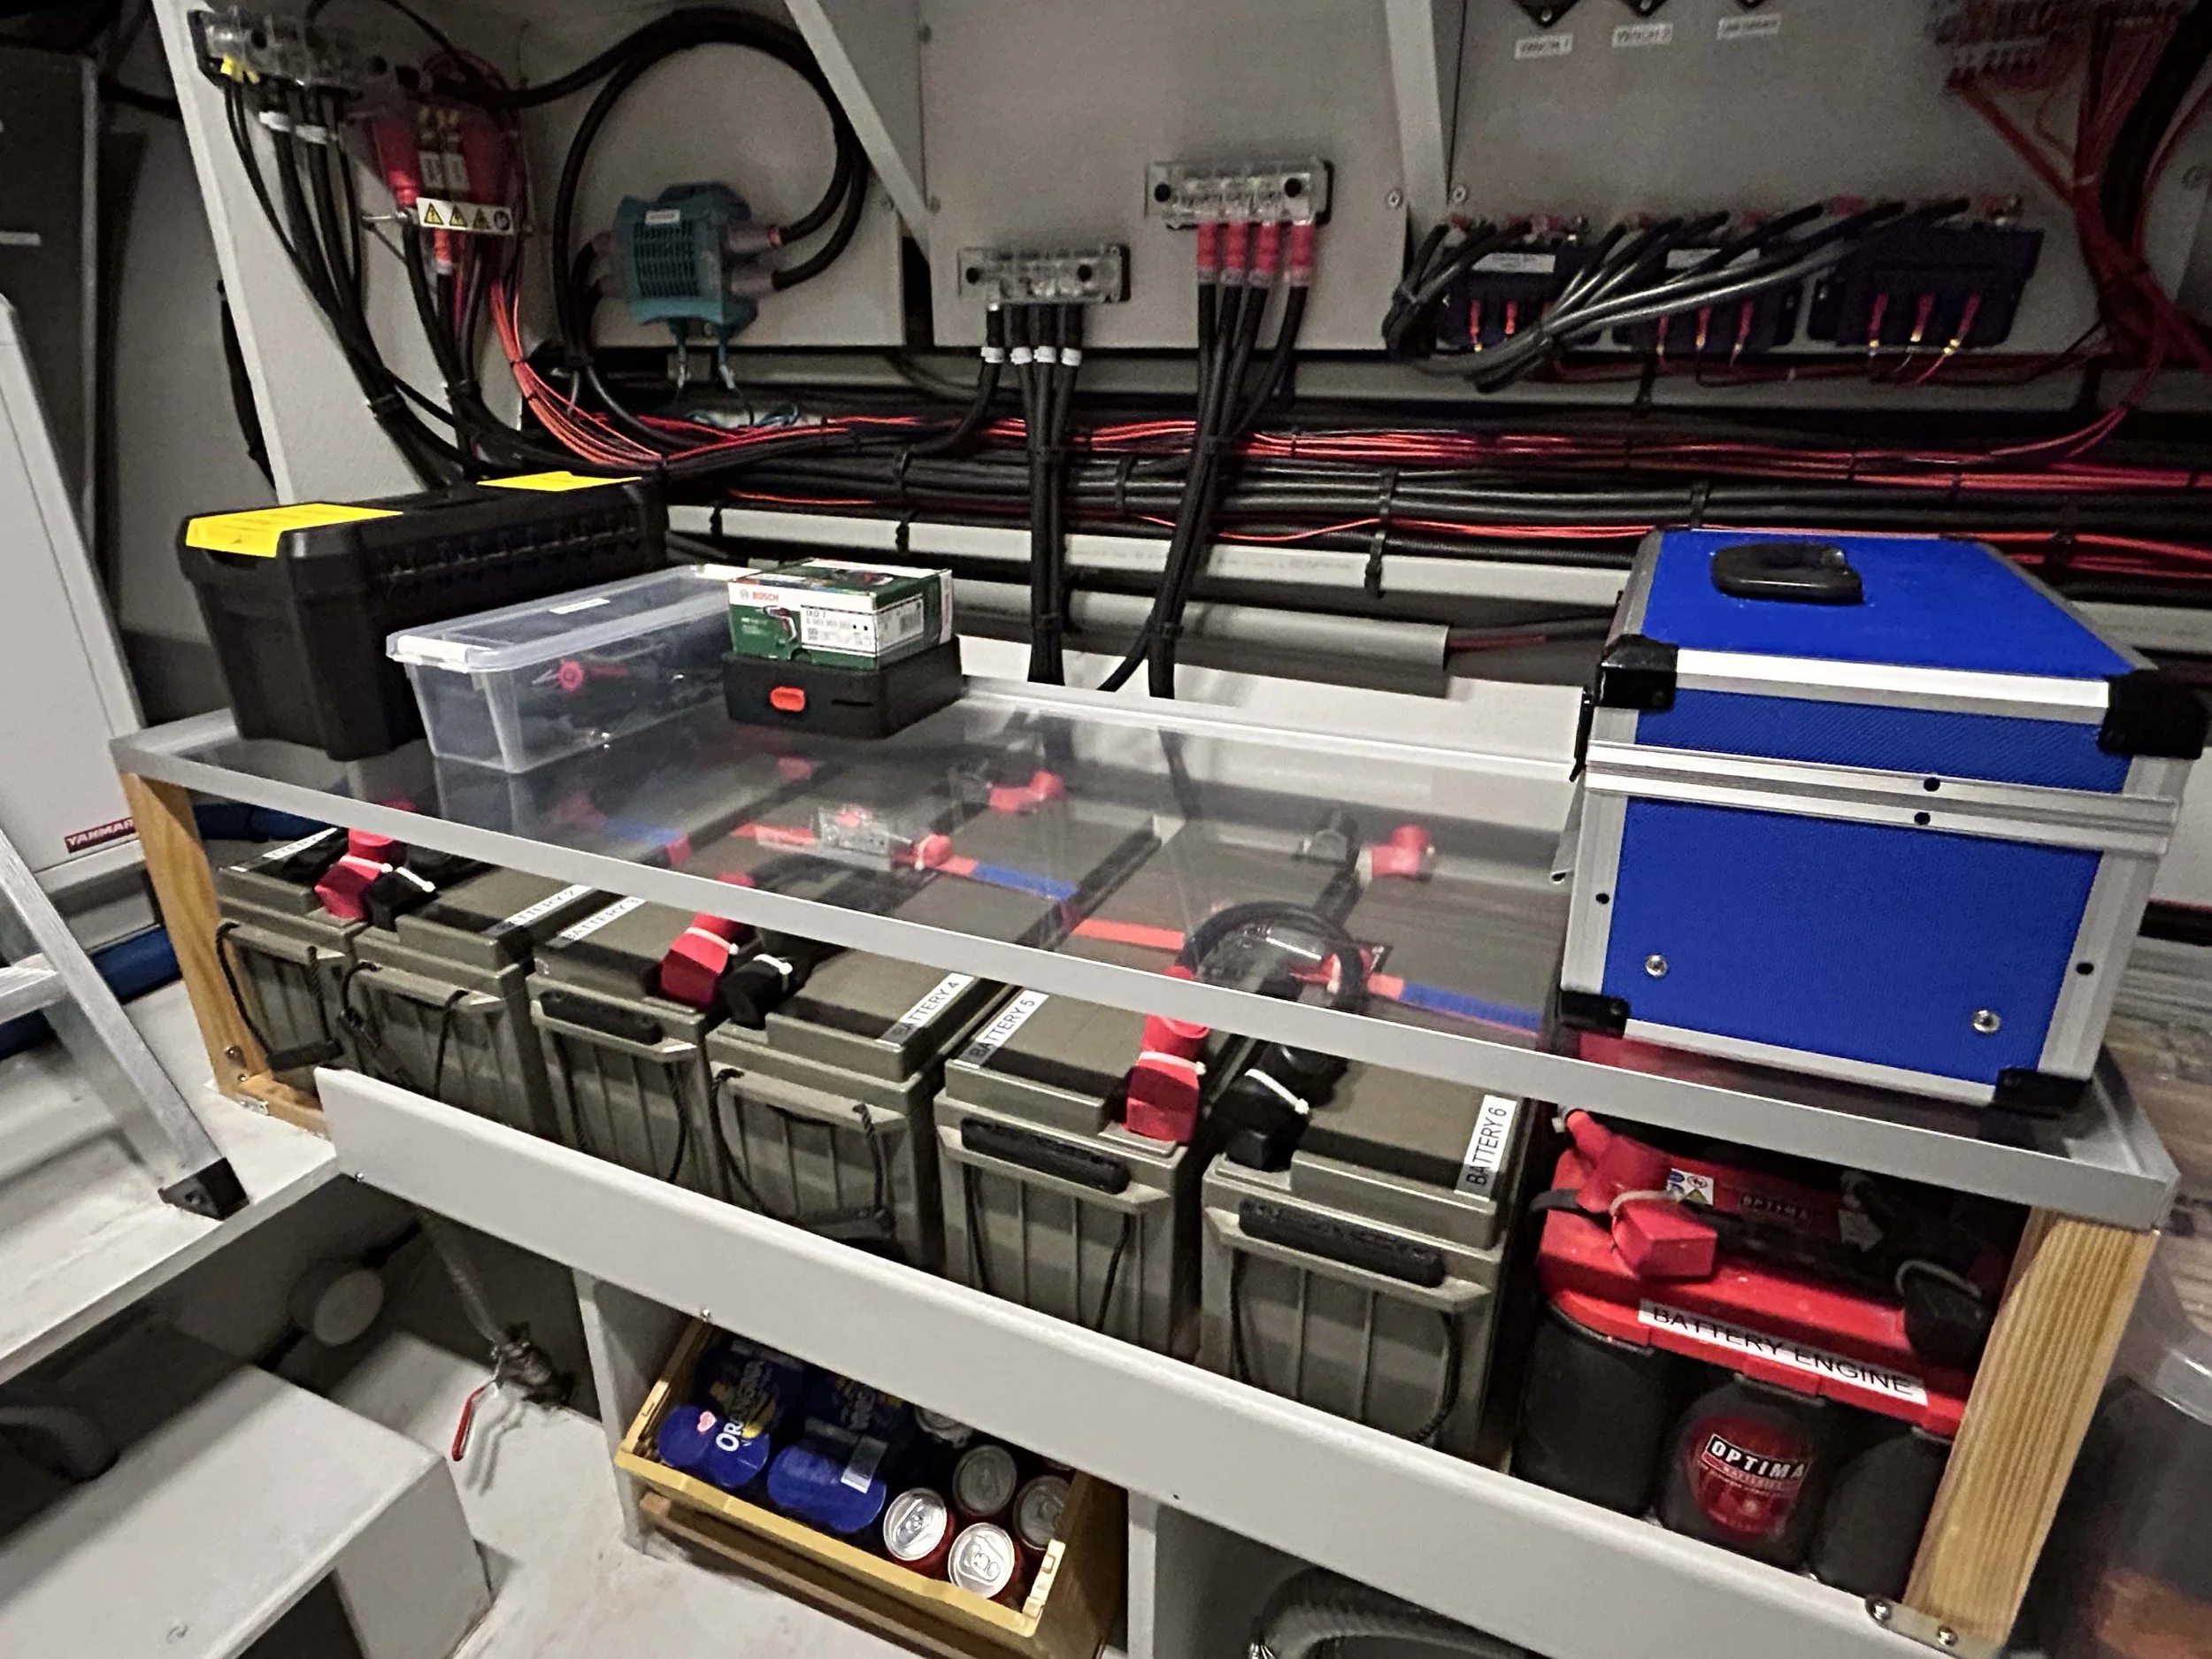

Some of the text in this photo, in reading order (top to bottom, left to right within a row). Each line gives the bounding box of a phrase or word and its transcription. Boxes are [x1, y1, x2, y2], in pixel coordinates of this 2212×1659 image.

[752, 591, 779, 602] BOSCH
[891, 988, 949, 1036] BATTERY
[970, 998, 1036, 1056] BATTERY 5
[1465, 1106, 1508, 1186] BATTERY 6
[1652, 1307, 1914, 1395] BATTERY ENGINE
[1710, 1440, 1805, 1479] OPTIMA
